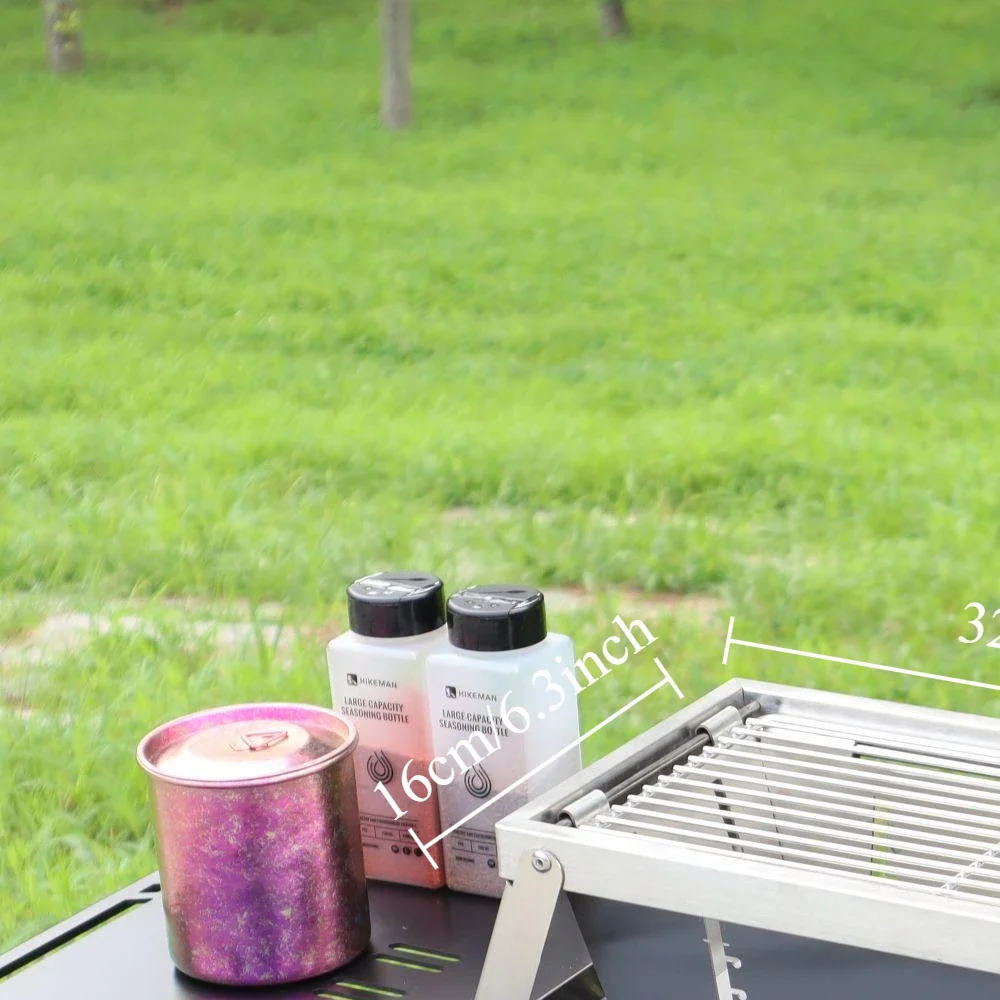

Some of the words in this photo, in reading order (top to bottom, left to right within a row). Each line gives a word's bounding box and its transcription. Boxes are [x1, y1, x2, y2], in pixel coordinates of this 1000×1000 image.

[360, 677, 397, 688] HIKEMAN
[459, 690, 497, 702] HIKEMAN
[344, 696, 367, 708] LARGE
[368, 699, 404, 712] CAPACITY
[341, 706, 382, 720] SEASONING
[383, 712, 409, 723] BOTTLE
[442, 709, 466, 720] LARGE
[466, 712, 504, 725] CAPACTY
[481, 725, 509, 737] BOTLE
